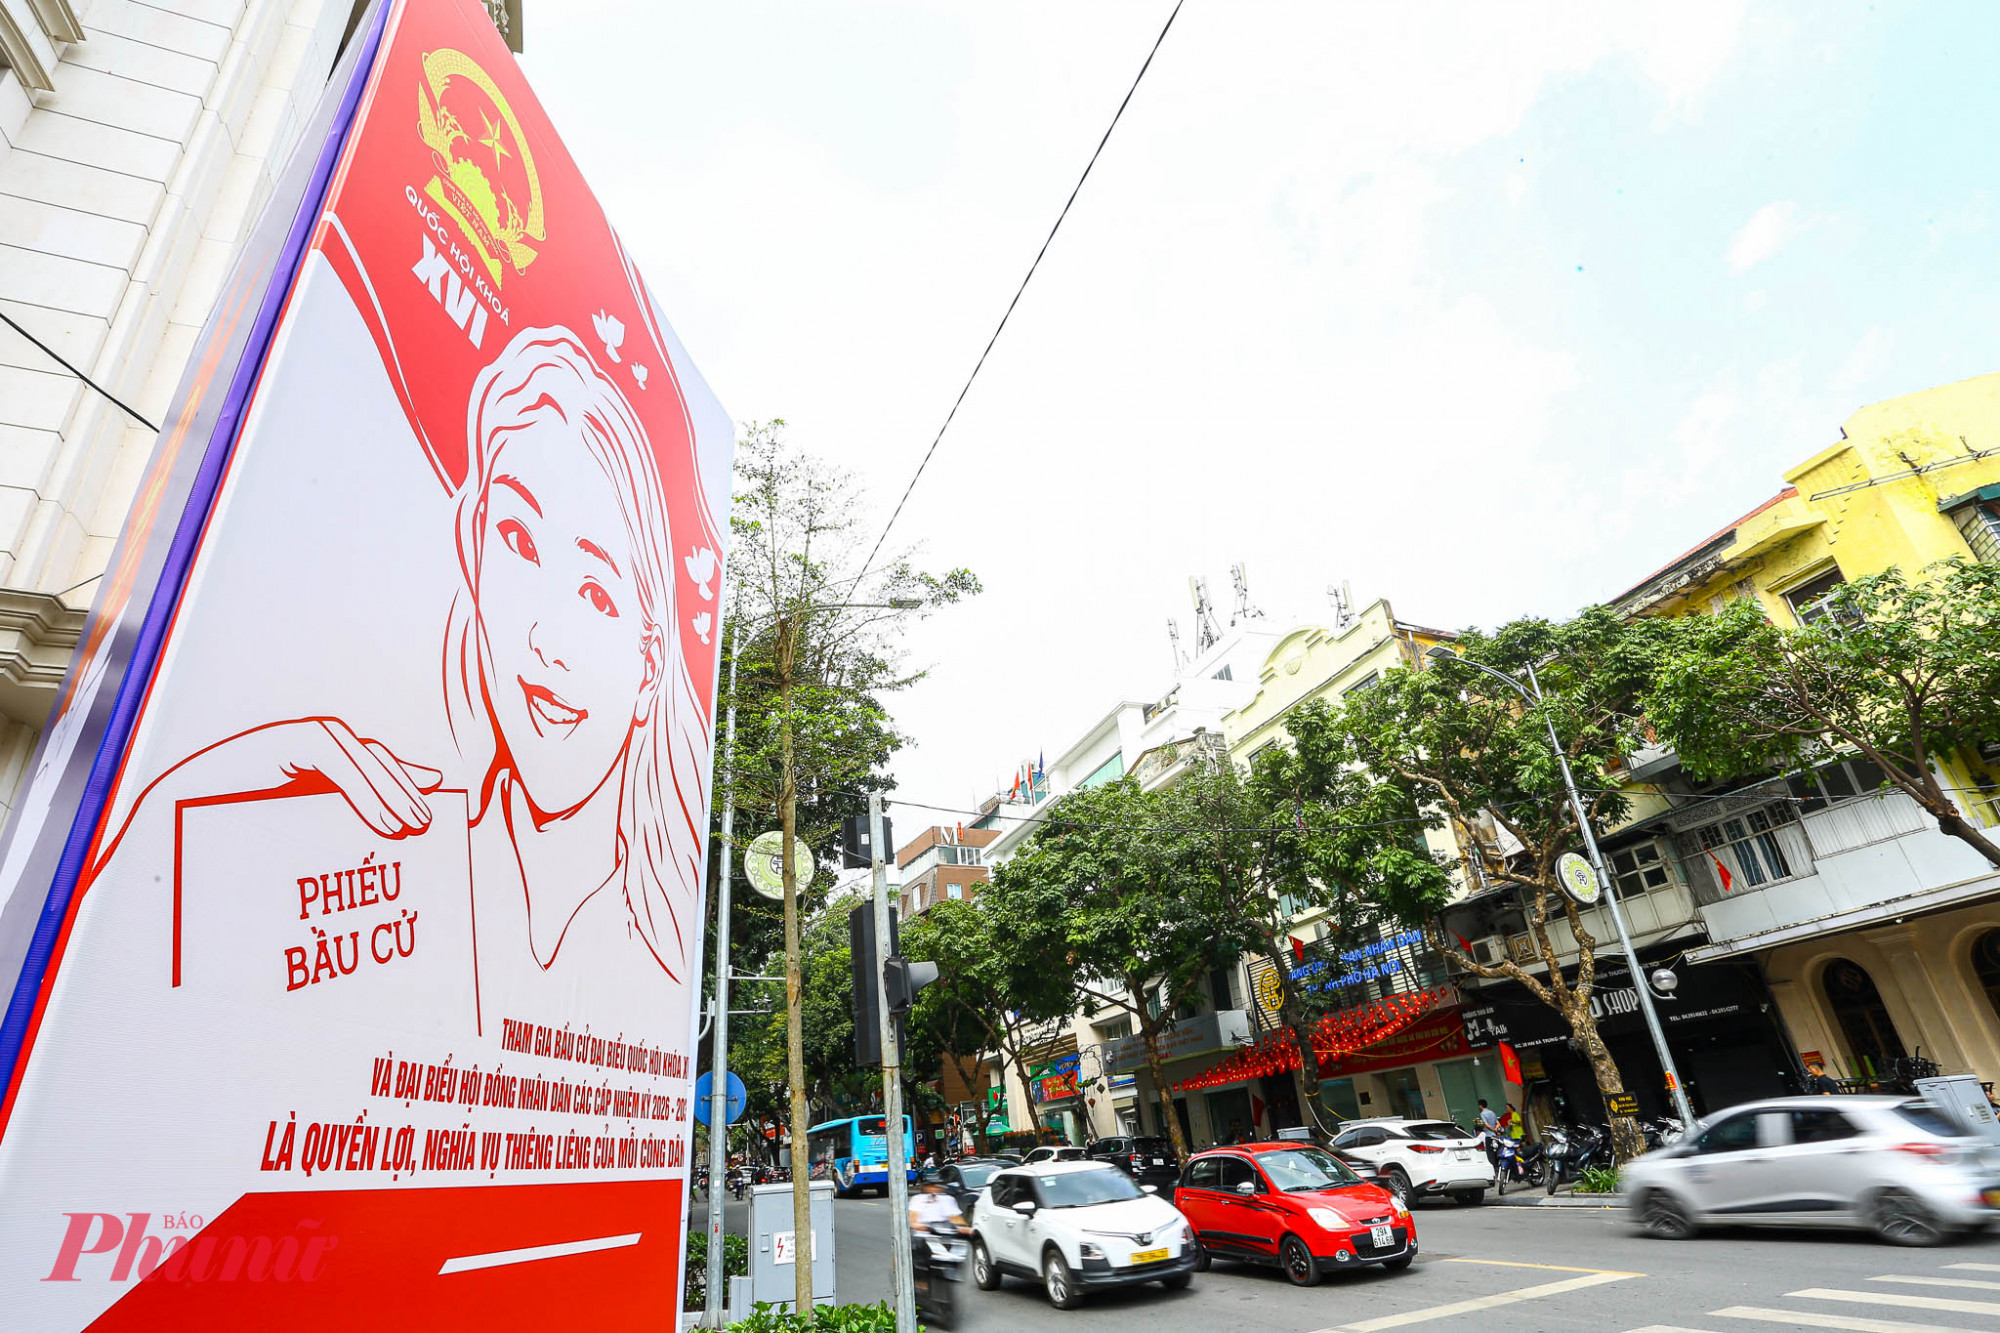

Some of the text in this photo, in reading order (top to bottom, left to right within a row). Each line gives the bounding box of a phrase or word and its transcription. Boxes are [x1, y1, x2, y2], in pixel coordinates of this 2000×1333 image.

[405, 185, 449, 245] QUỐC
[450, 242, 475, 279] HỘI
[411, 232, 488, 350] XVI
[297, 851, 401, 920] PHIẾU
[284, 909, 418, 992] BẦU CỬ
[1289, 964, 1310, 981] ẢNG
[1364, 937, 1396, 957] NHÂN
[1396, 928, 1422, 948] DÂN
[1306, 956, 1402, 997] THNH PHỐ HÀ NỘI
[1603, 988, 1639, 1016] SHOP
[501, 1018, 534, 1054] THAM
[534, 1025, 553, 1058] GIA
[554, 1021, 575, 1061] BẦU
[576, 1024, 591, 1064] CỬ
[590, 1037, 606, 1072] ĐẠI
[606, 1032, 626, 1070] BIỂU
[627, 1039, 648, 1074] QUỐC
[649, 1045, 662, 1081] HỘI
[662, 1049, 681, 1079] KHÓA
[371, 1051, 393, 1097] VÀ
[394, 1060, 423, 1108] ĐẠI
[424, 1053, 458, 1103] BIỂU
[458, 1064, 482, 1113] HỘI
[483, 1063, 517, 1108] ĐỒNG
[517, 1073, 550, 1111] NHÂN
[550, 1076, 573, 1114] DÂN
[573, 1079, 593, 1115] CÁC
[594, 1079, 612, 1116] CẤP
[613, 1085, 640, 1124] NHIỆM
[640, 1088, 652, 1119] KỲ
[651, 1095, 670, 1121] 2026
[260, 1109, 685, 1181] LÀ QUYỀN LỢI, NGHĨA VỤ THIÊNG LIÊNG CỦA MỖI CÔNG DÂN
[916, 1133, 923, 1143] P
[1376, 1227, 1388, 1237] 29A
